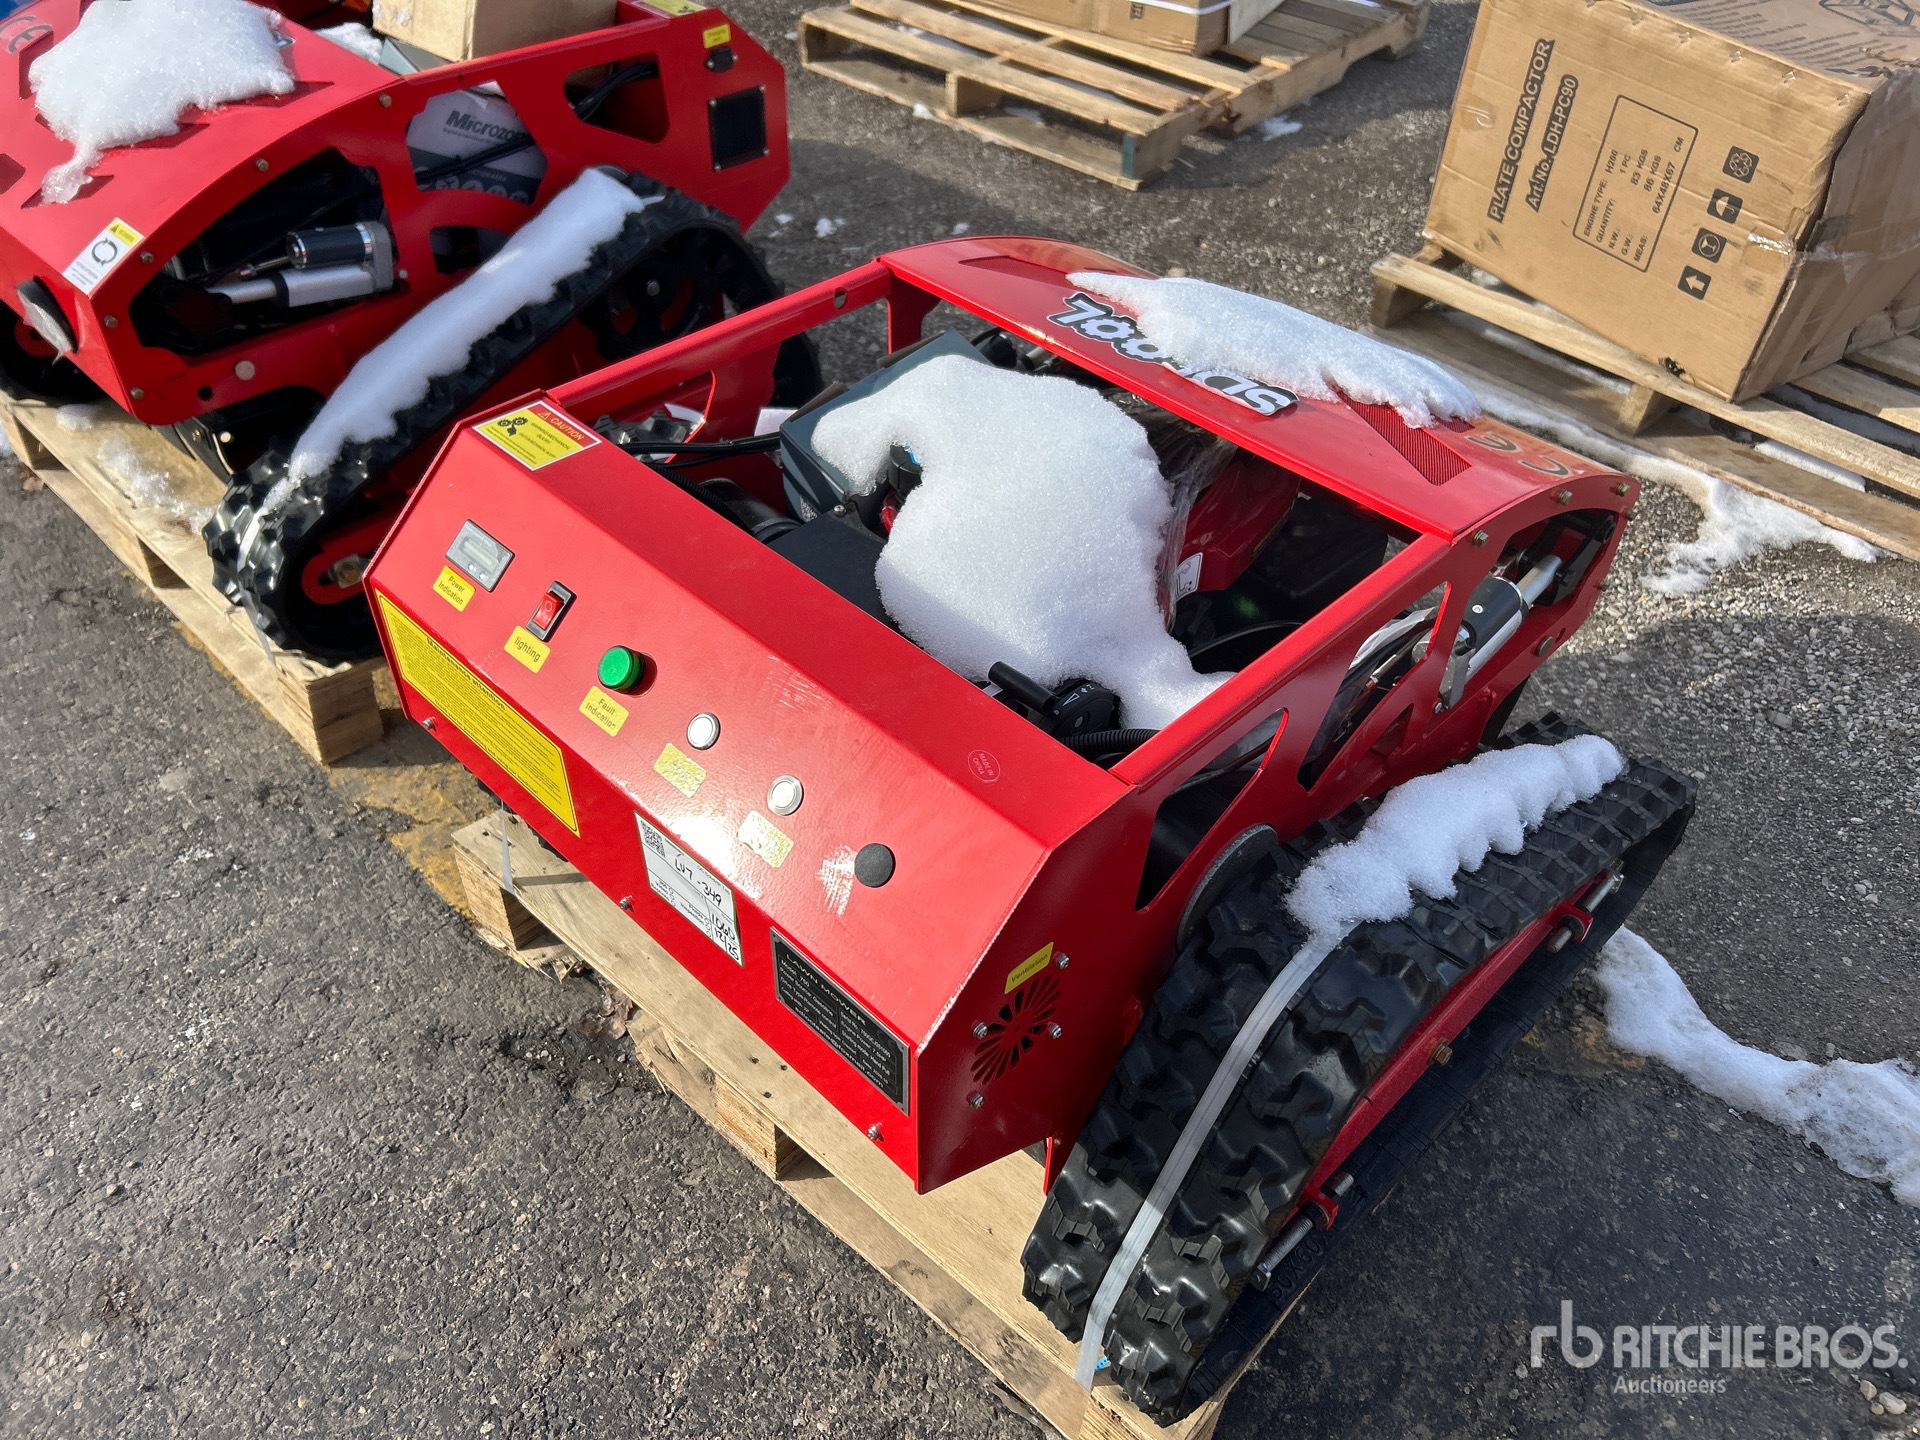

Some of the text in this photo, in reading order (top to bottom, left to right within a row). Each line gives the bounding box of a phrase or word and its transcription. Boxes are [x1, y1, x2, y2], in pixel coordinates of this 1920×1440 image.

[1543, 77, 1577, 155] LDH-PC90
[1489, 41, 1551, 220] PLATE COMPACTOR
[1673, 136, 1684, 153] CM
[1630, 172, 1641, 185] 83
[1636, 149, 1648, 169] KGS
[1649, 155, 1662, 175] KGS
[1583, 204, 1599, 237] ENGINE
[1594, 179, 1608, 204] TYPE:
[1595, 198, 1616, 243] QUANTITY:
[1622, 154, 1631, 168] PC
[550, 417, 585, 441] CAUTION
[438, 582, 464, 605] Indication
[448, 576, 465, 593] Power
[514, 636, 541, 662] lighting
[585, 703, 617, 730] Indication
[598, 698, 616, 715] Fault
[972, 757, 985, 774] CHINA
[978, 752, 991, 769] MADE
[1011, 953, 1048, 982] Ventilation
[786, 953, 867, 1026] LAWN MOWER
